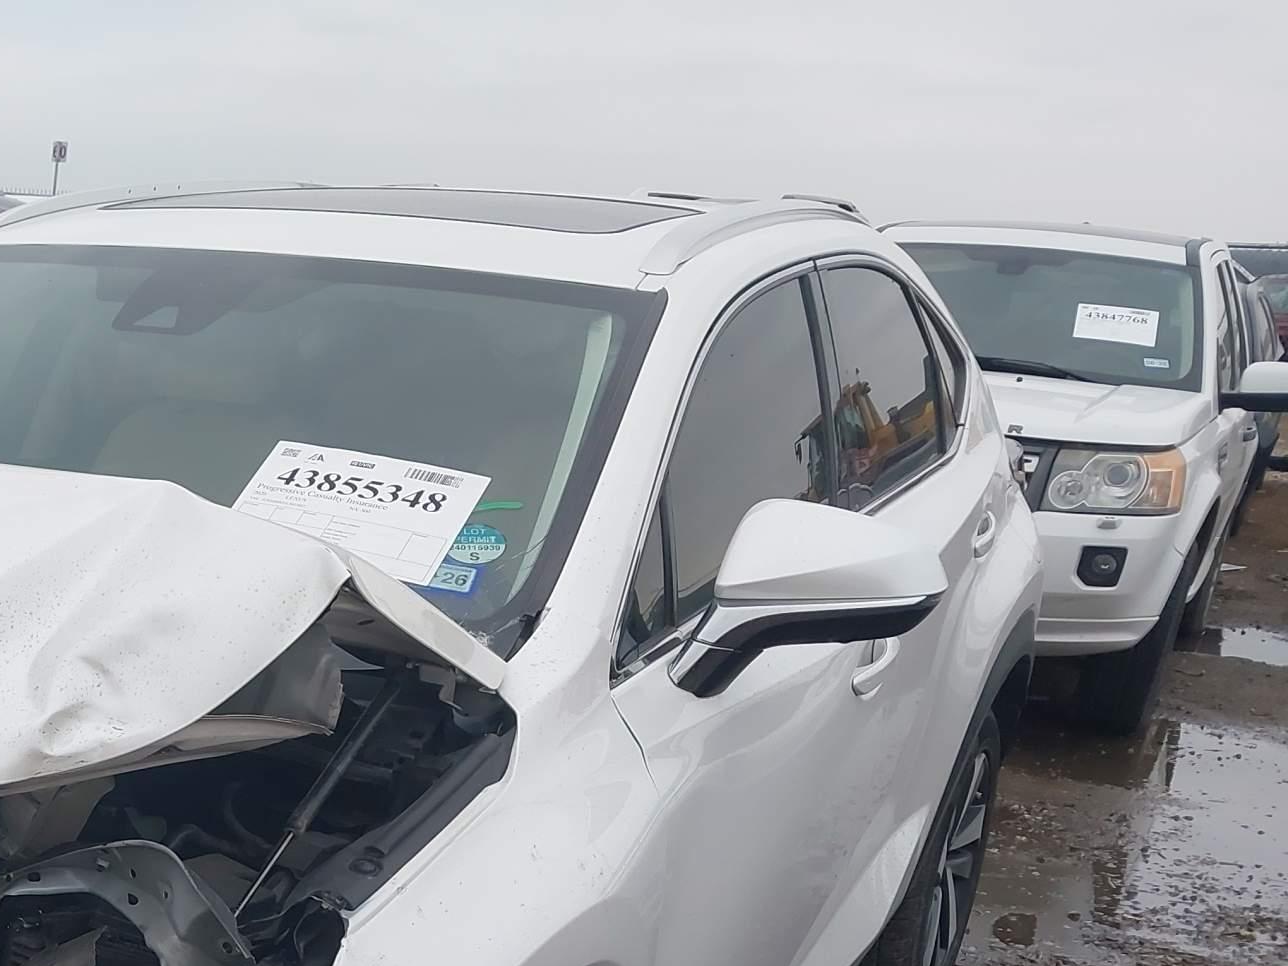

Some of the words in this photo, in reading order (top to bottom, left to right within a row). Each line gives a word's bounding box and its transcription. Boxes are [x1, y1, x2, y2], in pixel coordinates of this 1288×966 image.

[1085, 311, 1149, 325] 43847768
[257, 482, 306, 497] Progressive
[307, 490, 344, 503] Casualty
[345, 497, 389, 511] Insurance
[276, 466, 448, 513] 43855348
[469, 552, 480, 561] S
